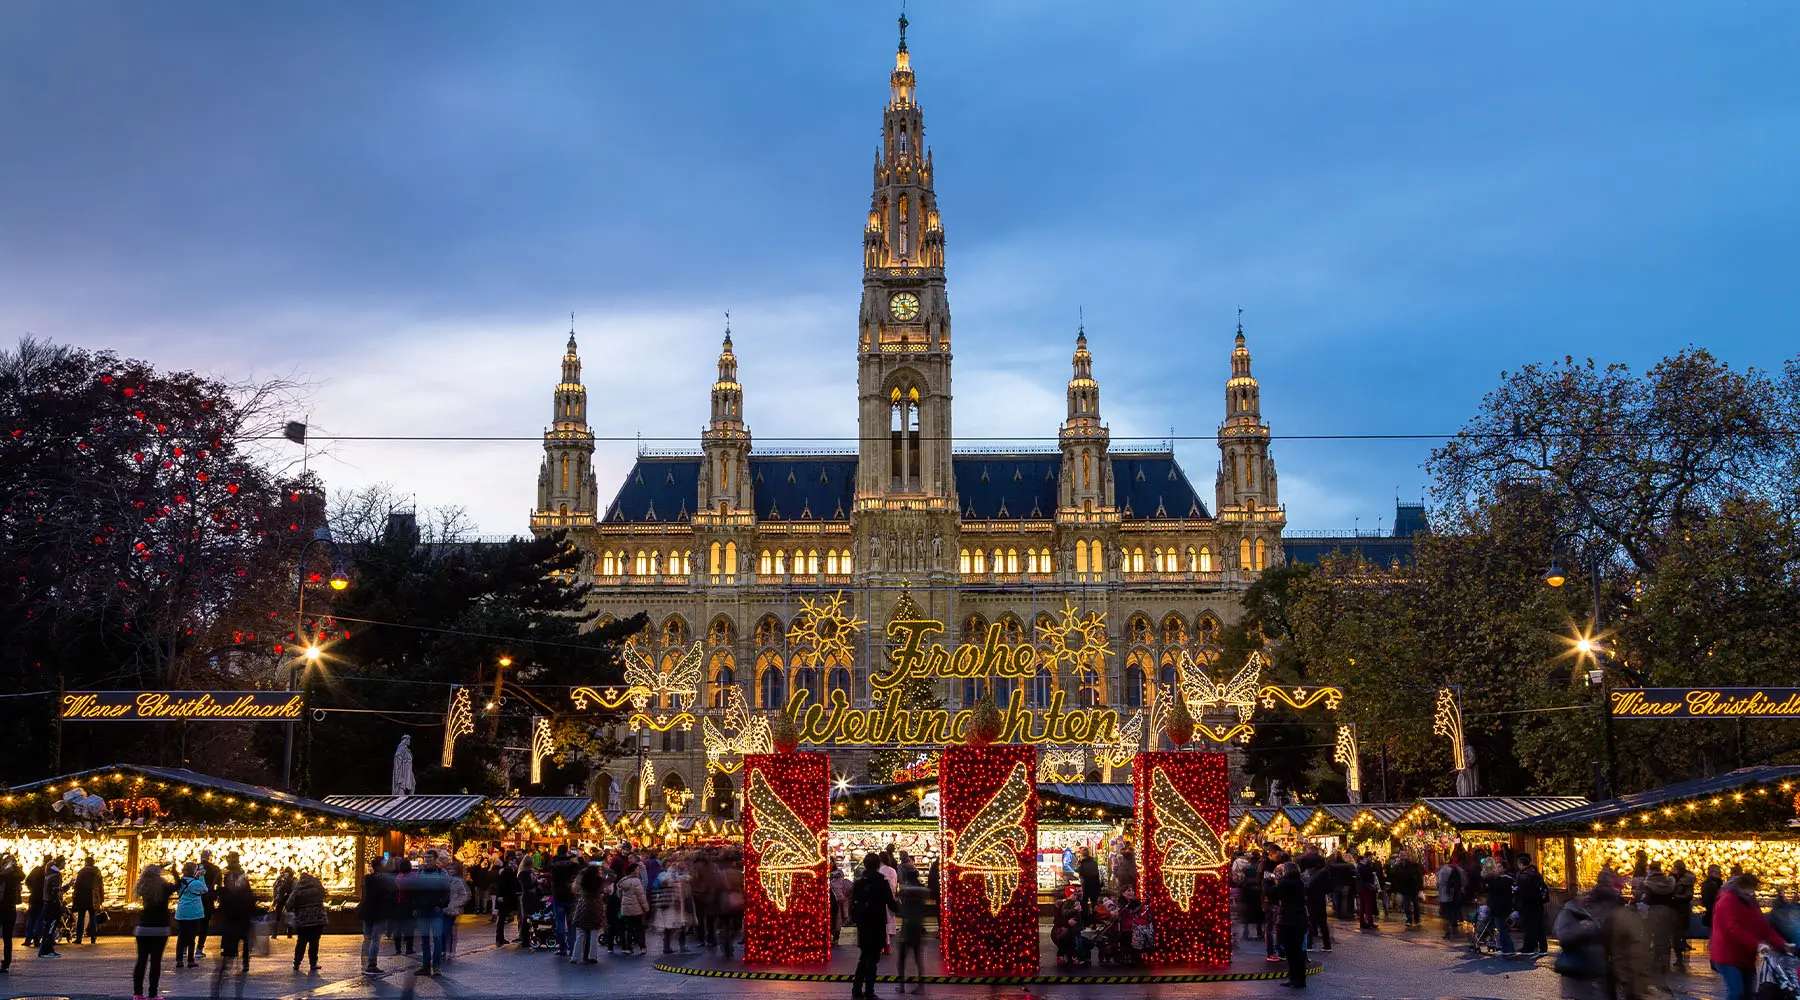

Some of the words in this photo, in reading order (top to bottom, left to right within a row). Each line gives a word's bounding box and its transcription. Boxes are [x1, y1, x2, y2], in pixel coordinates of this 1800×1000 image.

[869, 620, 1036, 688] Frohe
[63, 694, 132, 717] Wiener
[136, 693, 304, 717] Christkindlmarkt
[1611, 691, 1682, 715] Wiener
[1686, 690, 1800, 715] Christkindl
